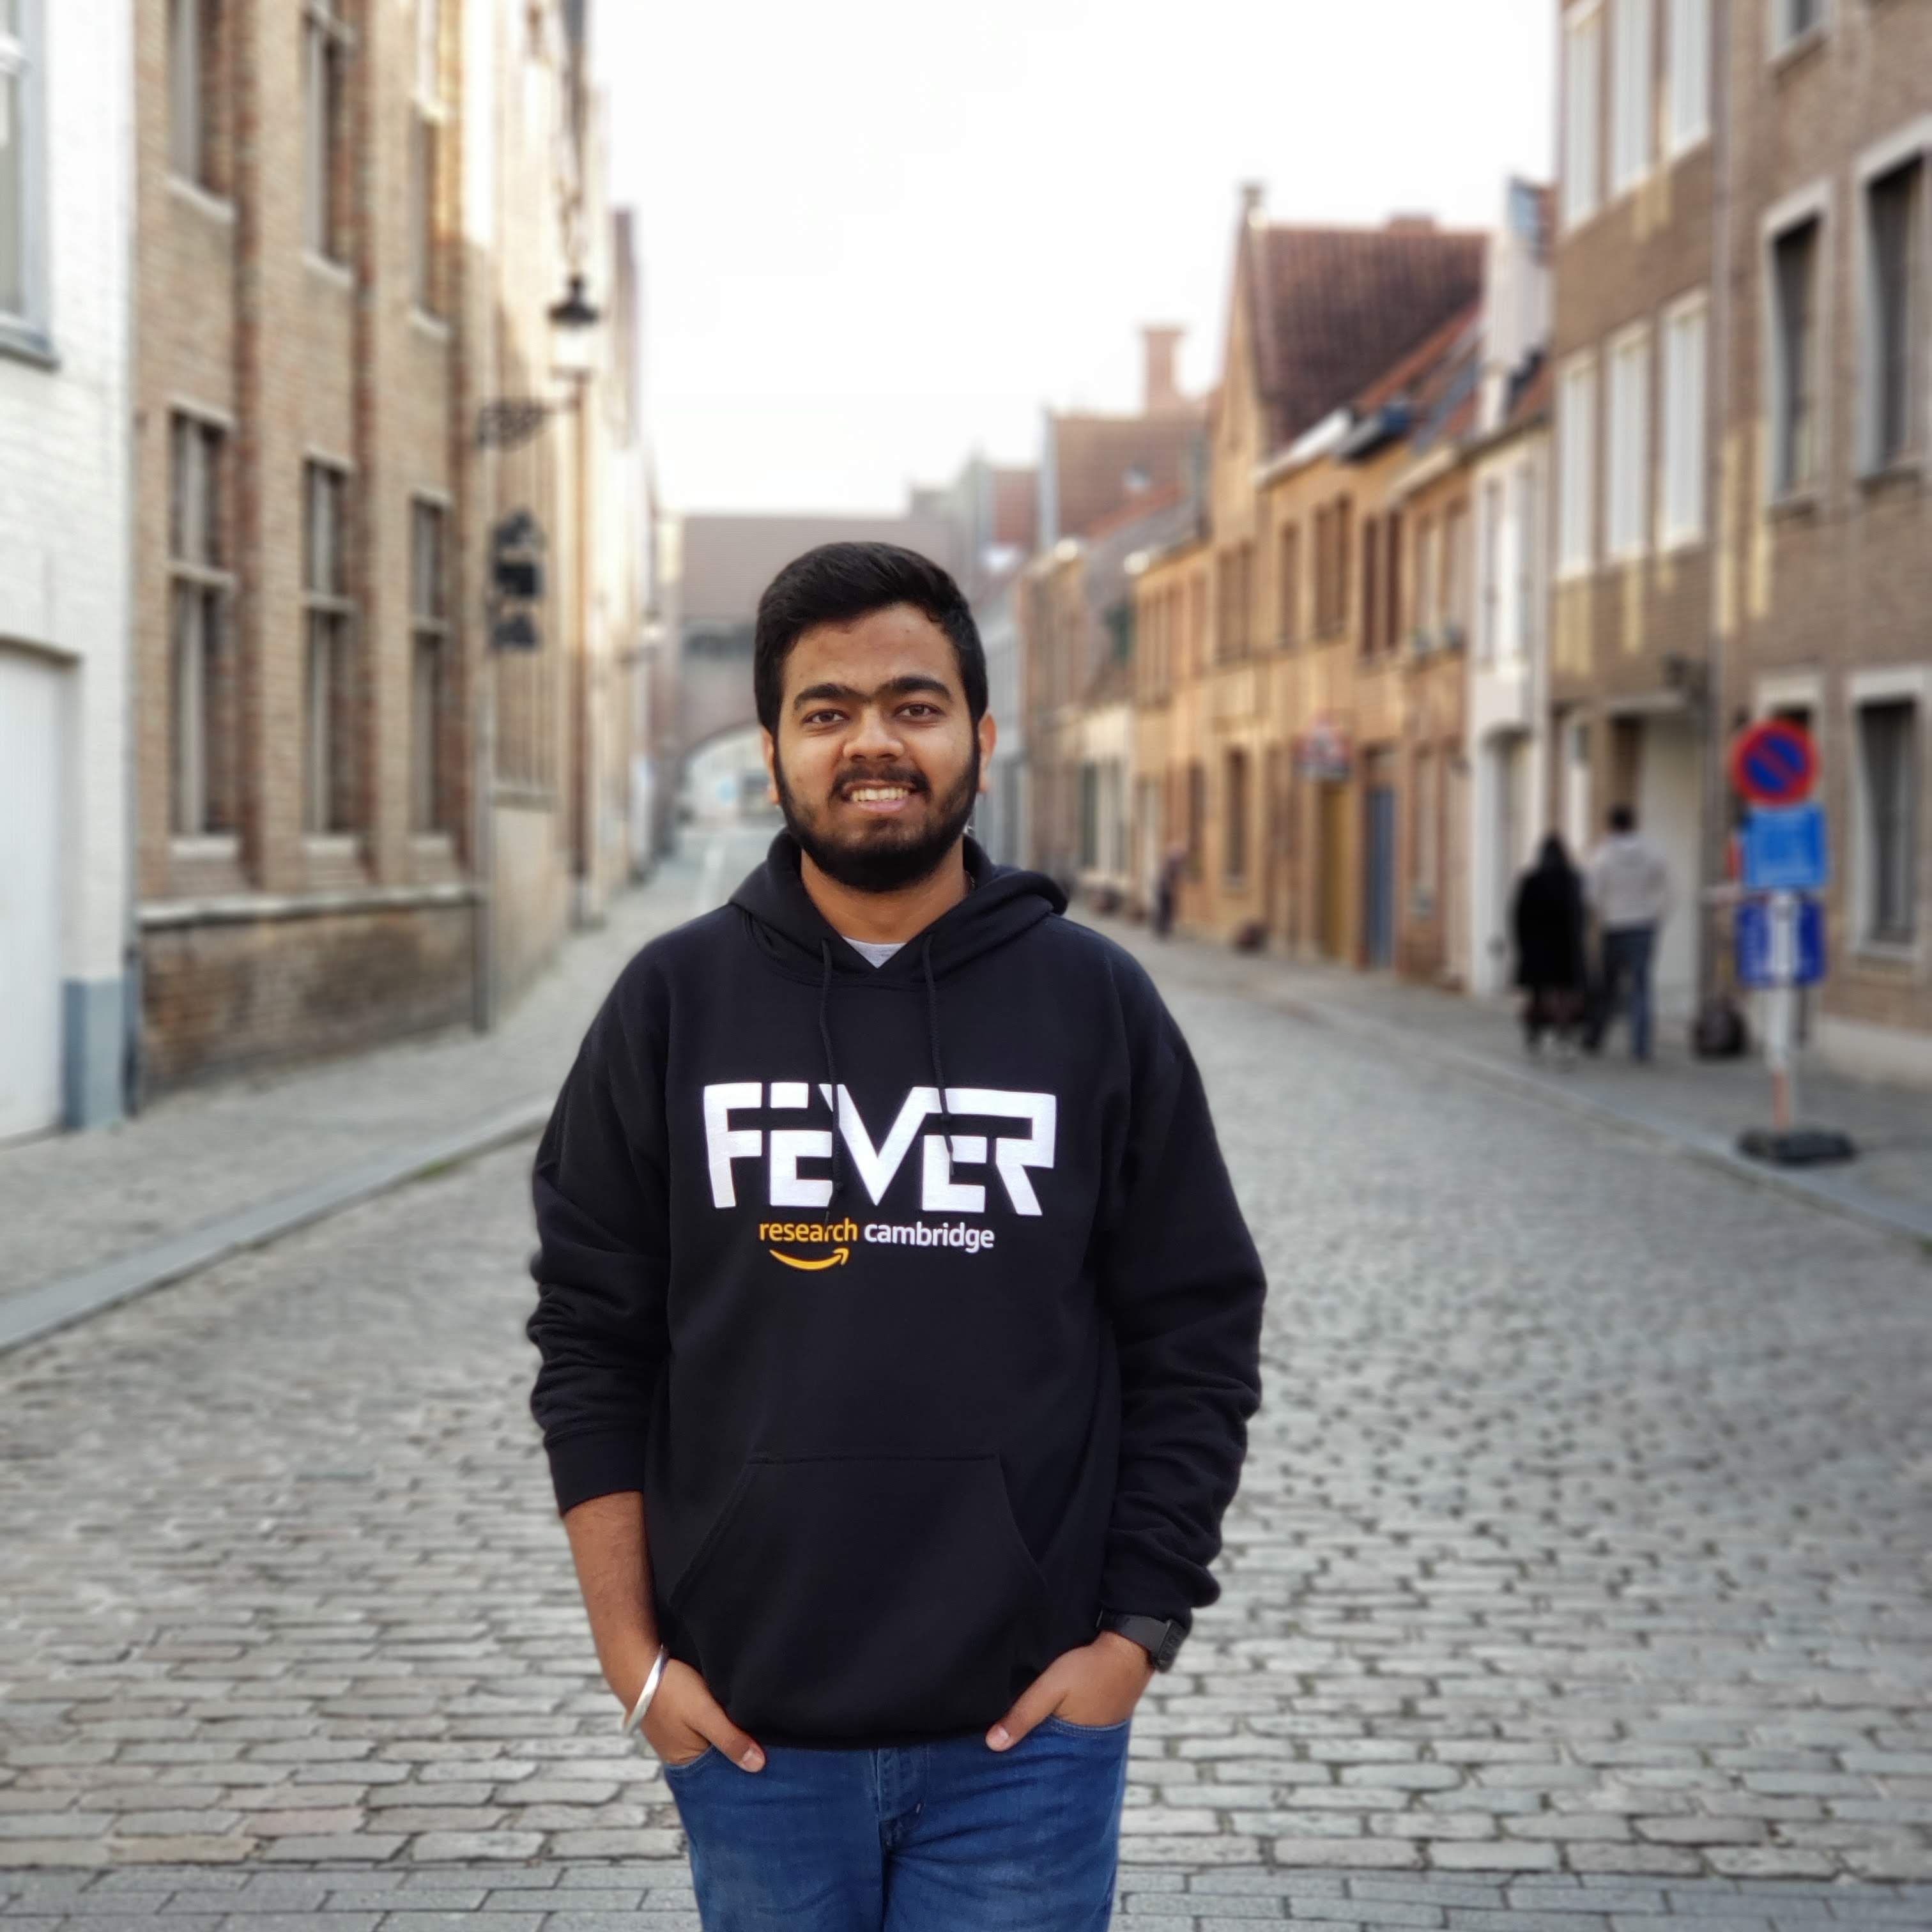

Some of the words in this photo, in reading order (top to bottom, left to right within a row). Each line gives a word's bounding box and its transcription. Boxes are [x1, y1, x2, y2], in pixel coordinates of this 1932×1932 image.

[703, 1082, 1057, 1216] FEVER
[759, 1217, 859, 1243] research
[864, 1221, 995, 1254] cambridge
